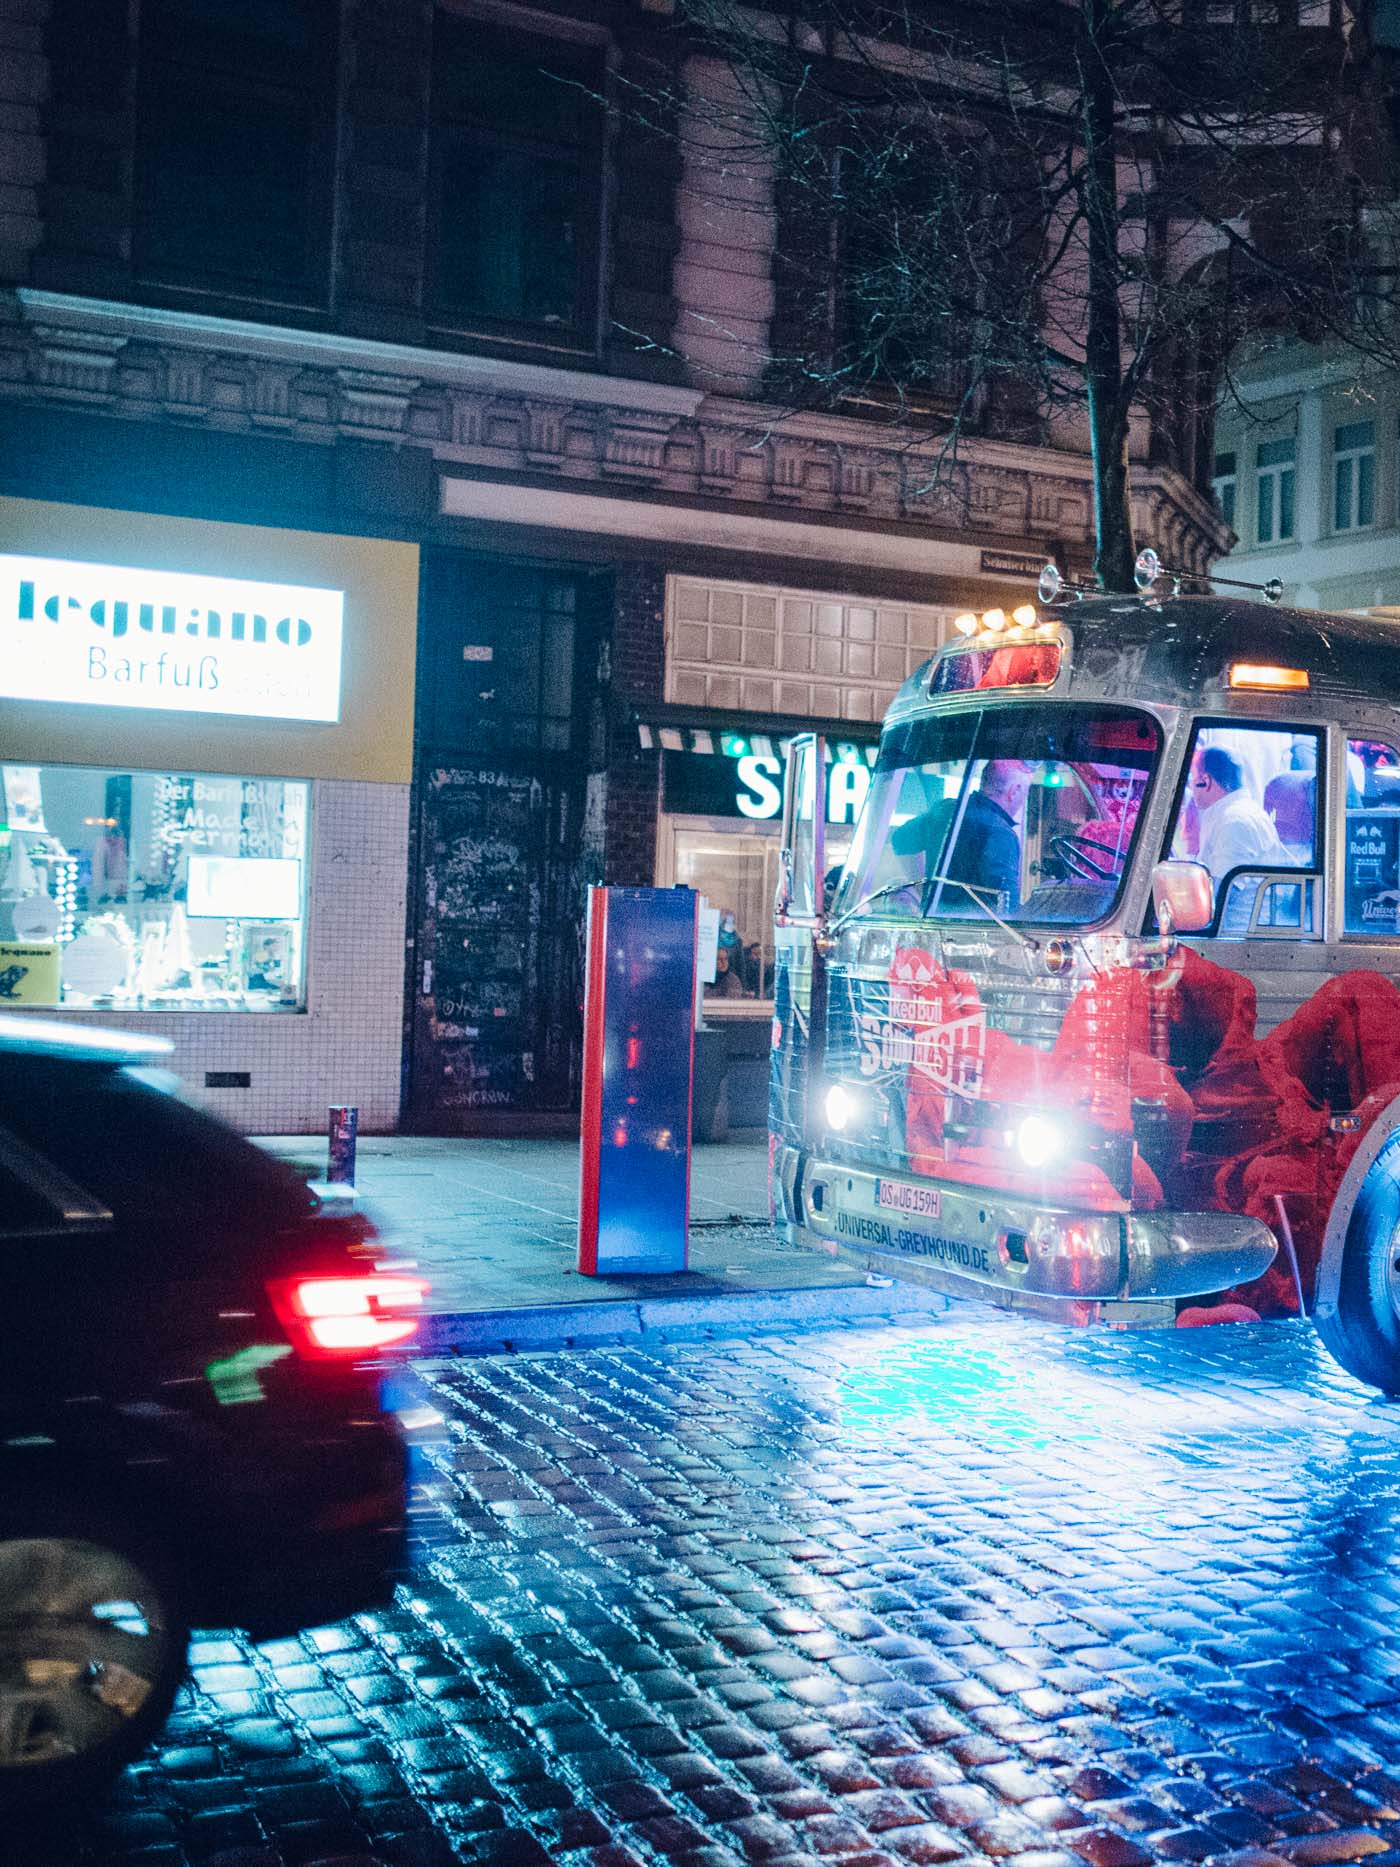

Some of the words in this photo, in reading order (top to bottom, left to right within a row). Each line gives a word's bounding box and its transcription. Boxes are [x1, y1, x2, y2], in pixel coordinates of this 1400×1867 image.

[18, 580, 312, 646] leguano
[88, 646, 219, 690] Barfuß
[479, 771, 495, 784] 83
[1351, 842, 1368, 854] Red
[1369, 842, 1386, 855] Bull
